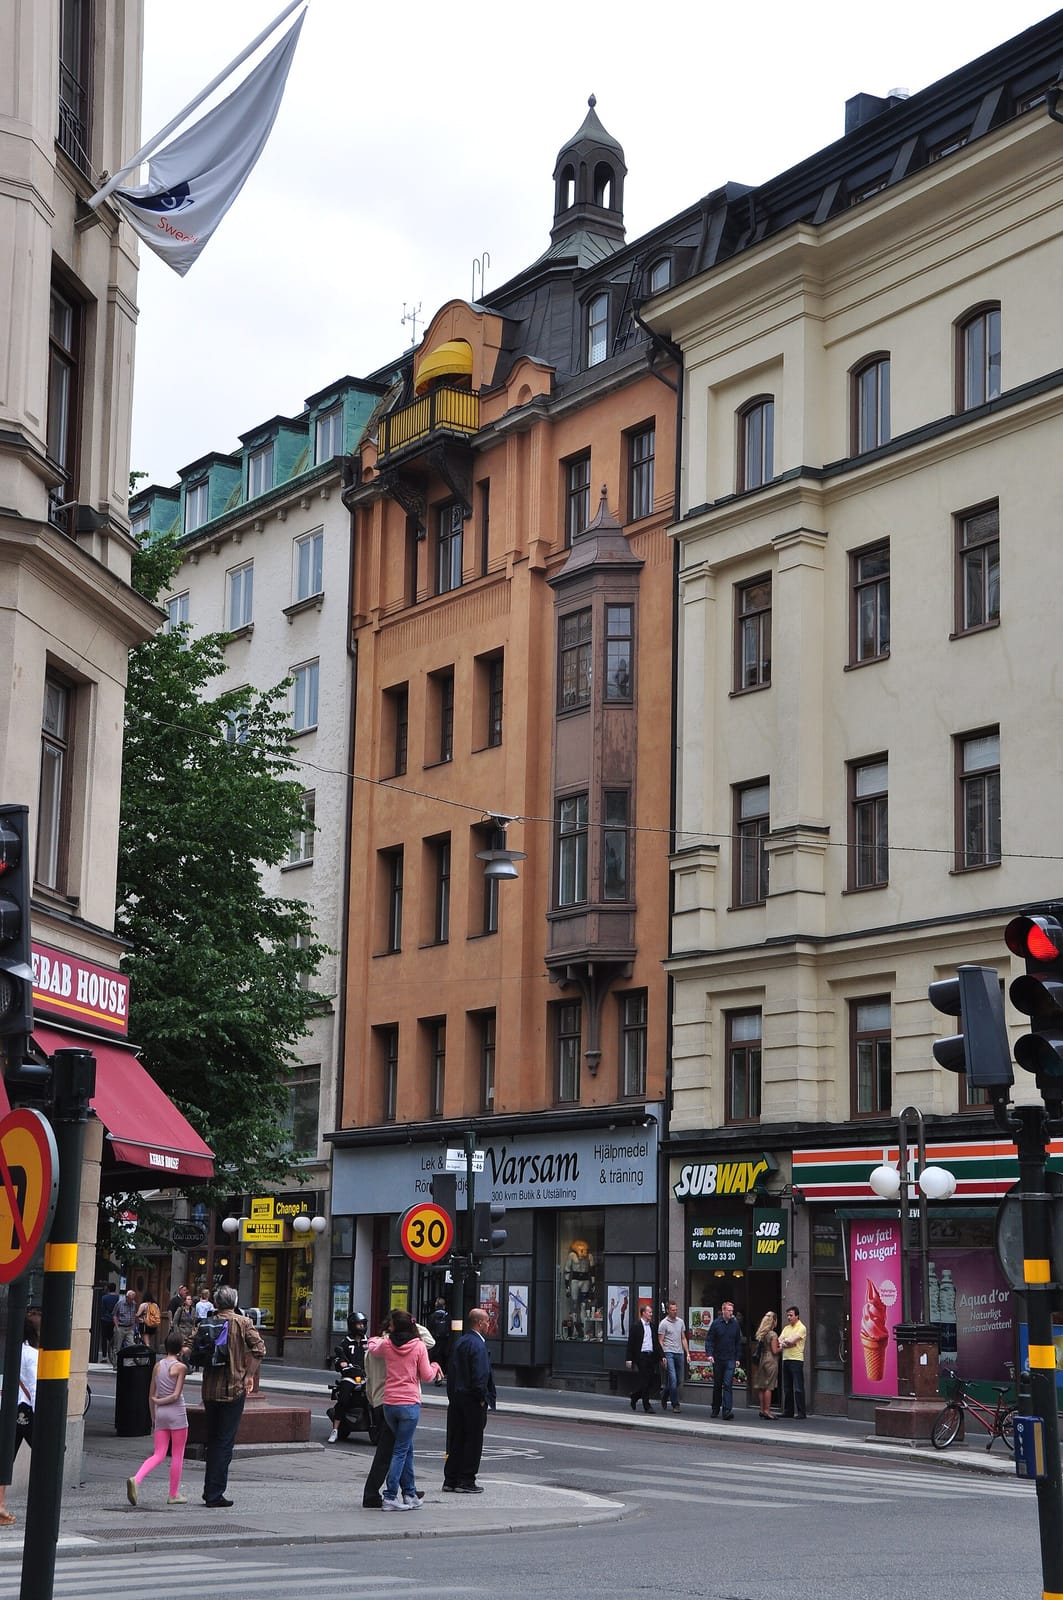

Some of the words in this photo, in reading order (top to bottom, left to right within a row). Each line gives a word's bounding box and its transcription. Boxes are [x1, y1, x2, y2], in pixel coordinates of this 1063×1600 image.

[31, 952, 71, 997] EBAB
[77, 968, 126, 1016] HOUSE
[594, 1142, 649, 1163] Hjälpmedel
[421, 1156, 435, 1170] Lek
[437, 1156, 444, 1170] &
[485, 1146, 579, 1186] Varsam
[600, 1168, 607, 1184] &
[610, 1166, 643, 1186] träning
[675, 1159, 768, 1196] SUBWAY
[491, 1191, 503, 1202] 300
[505, 1190, 518, 1202] kvm
[520, 1190, 534, 1201] Butik
[536, 1189, 541, 1200] &
[543, 1188, 577, 1201] Utställning
[276, 1202, 300, 1217] Change
[301, 1201, 308, 1213] In
[410, 1219, 445, 1248] 30
[717, 1227, 743, 1237] Catering
[756, 1222, 781, 1237] SUB
[856, 1232, 874, 1246] Low
[875, 1227, 892, 1246] fat!
[703, 1240, 715, 1248] Alla
[716, 1240, 742, 1248] Tillfällen
[757, 1239, 785, 1254] WAY
[698, 1253, 718, 1261] 08-720
[719, 1253, 727, 1261] 33
[728, 1253, 736, 1261] 20
[854, 1248, 868, 1261] No
[869, 1243, 897, 1262] sugar!
[960, 1294, 987, 1309] Aqua
[970, 1308, 1002, 1321] Naturligt
[962, 1318, 1012, 1334] mineralvatten!
[349, 1345, 355, 1355] 7
